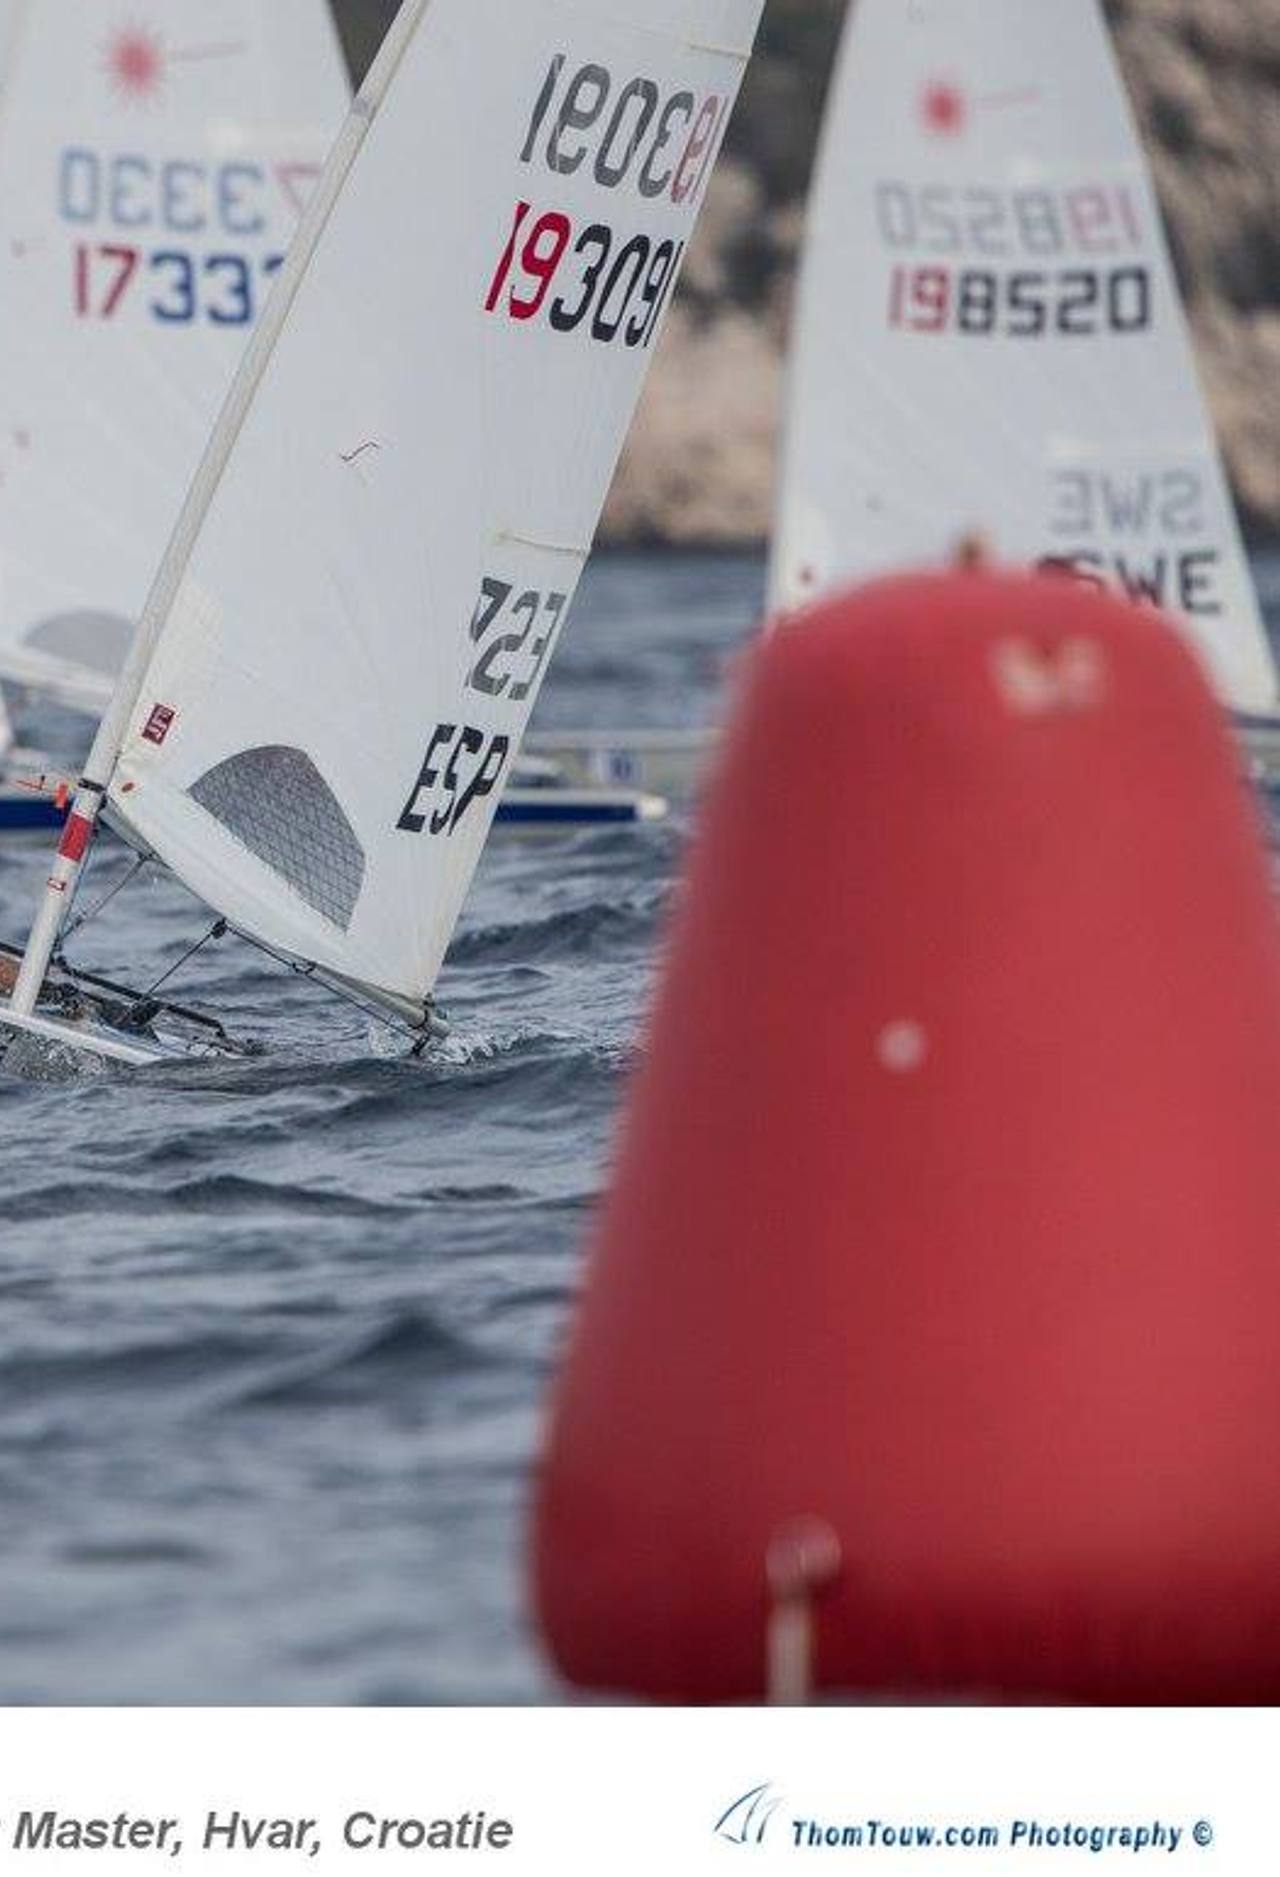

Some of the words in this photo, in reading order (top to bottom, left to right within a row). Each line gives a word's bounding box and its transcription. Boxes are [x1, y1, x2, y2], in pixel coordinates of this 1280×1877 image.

[74, 243, 286, 324] 1733
[483, 199, 685, 348] 193091
[886, 264, 1151, 335] 198520
[396, 723, 509, 836] ESP
